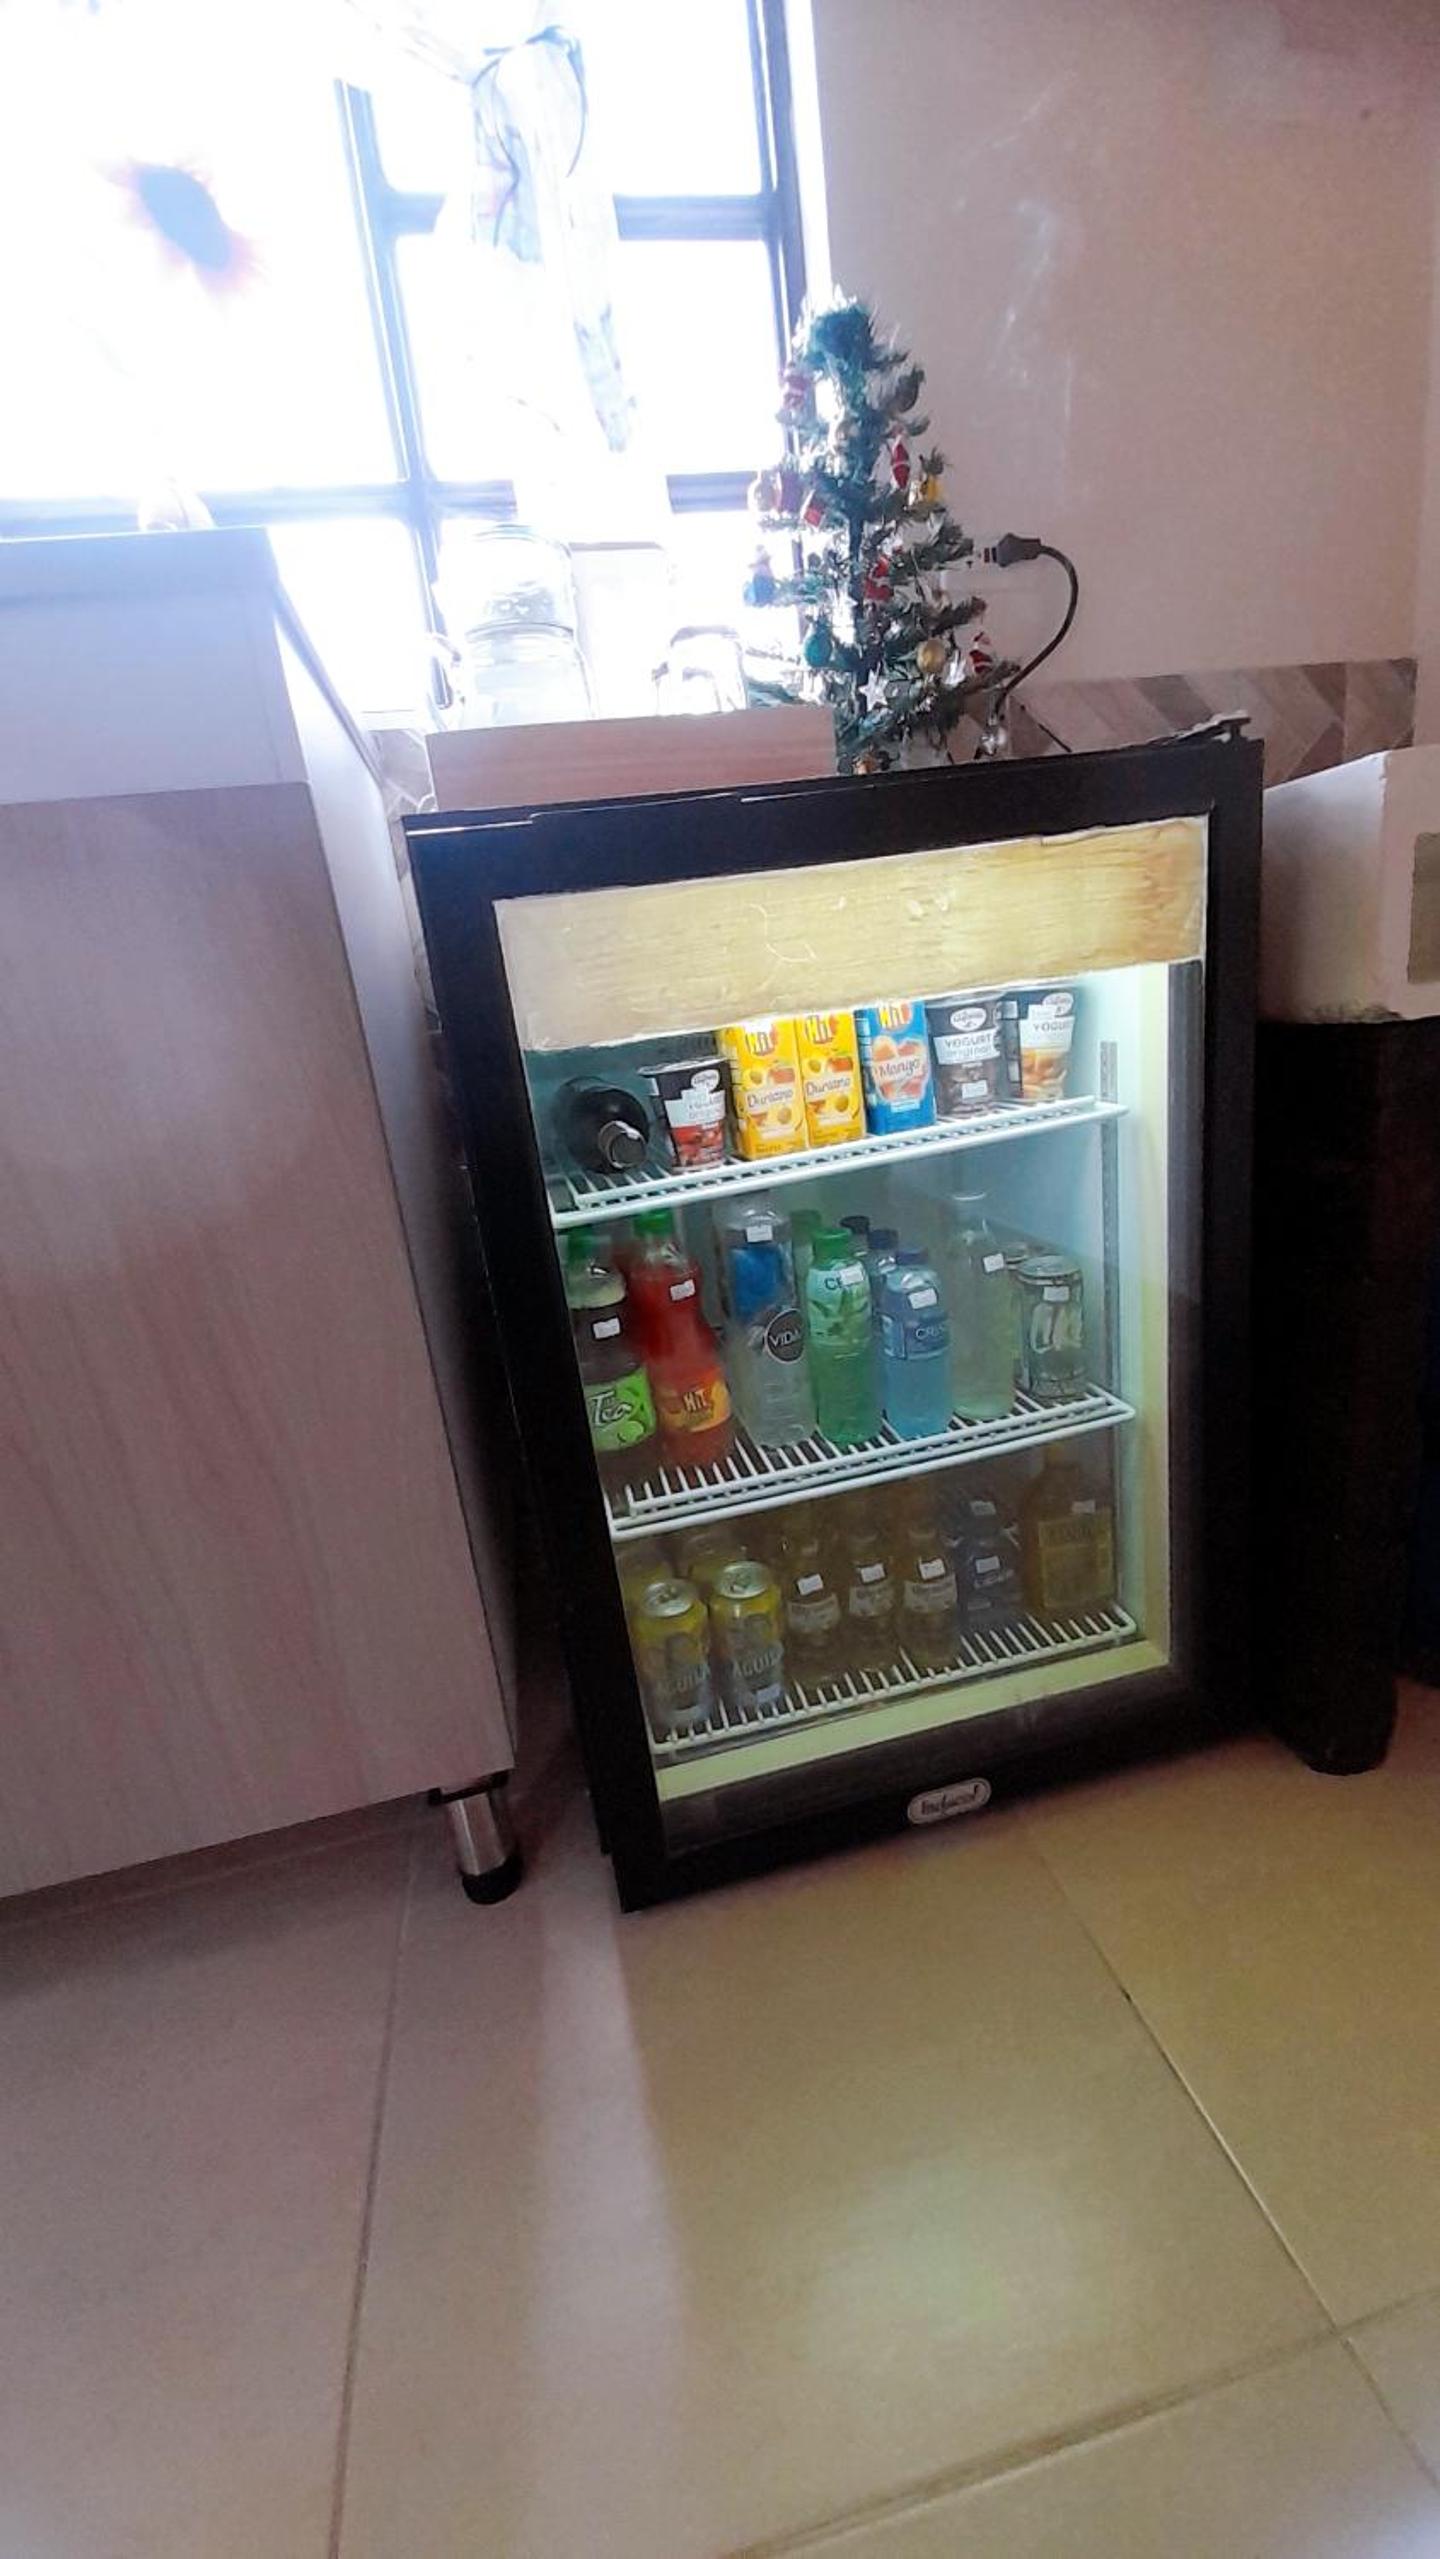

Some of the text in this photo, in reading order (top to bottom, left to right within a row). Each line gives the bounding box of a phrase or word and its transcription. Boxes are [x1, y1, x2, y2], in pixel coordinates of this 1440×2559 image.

[944, 1032, 992, 1049] YOGURT
[879, 1057, 921, 1083] Mango
[806, 1077, 851, 1098] Durazno
[747, 1088, 794, 1108] Durazno
